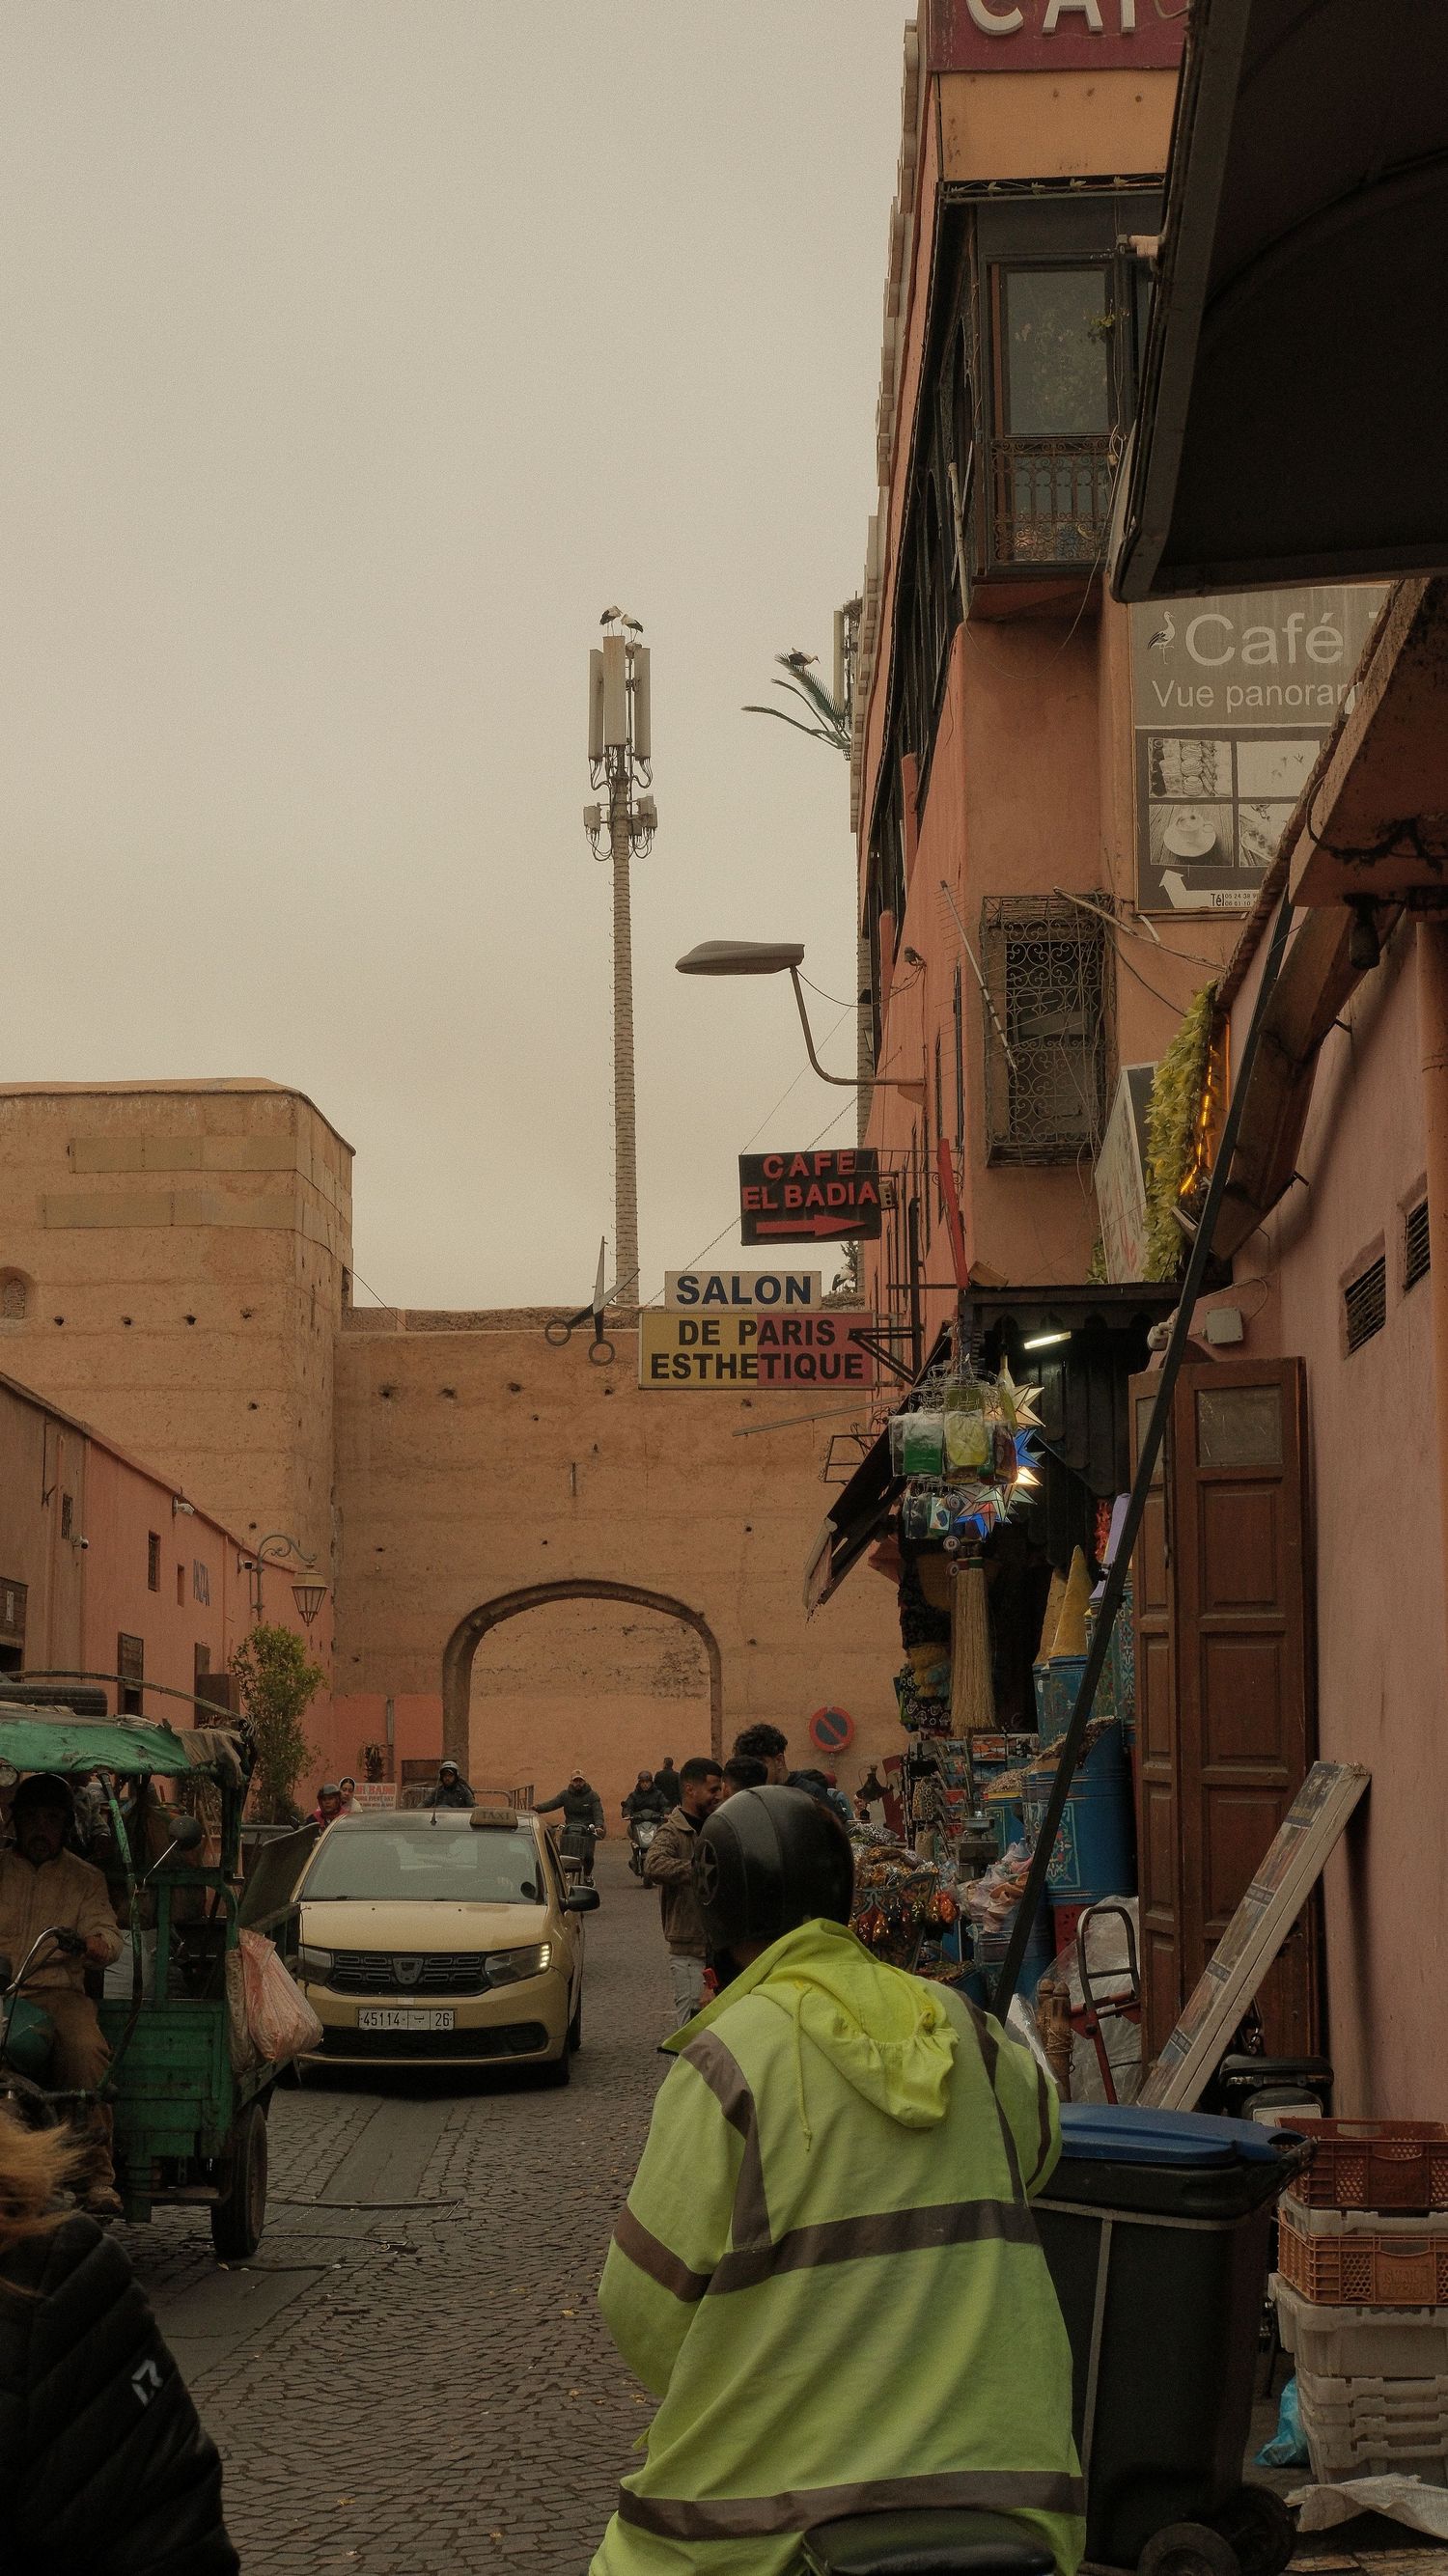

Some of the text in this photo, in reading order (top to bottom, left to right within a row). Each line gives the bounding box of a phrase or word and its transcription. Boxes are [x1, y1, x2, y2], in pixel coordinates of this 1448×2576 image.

[1184, 612, 1345, 666] Café
[1152, 679, 1214, 708] Vue
[1211, 893, 1225, 906] Tél
[763, 1150, 856, 1179] CAFE
[742, 1180, 877, 1209] EL BADIA
[676, 1275, 811, 1305] SALON
[679, 1319, 836, 1345] DE PARIS
[651, 1353, 863, 1381] ESTHETIQUE
[481, 1811, 511, 1819] TAXI
[363, 2012, 400, 2026] 45114
[435, 2012, 450, 2027] 26
